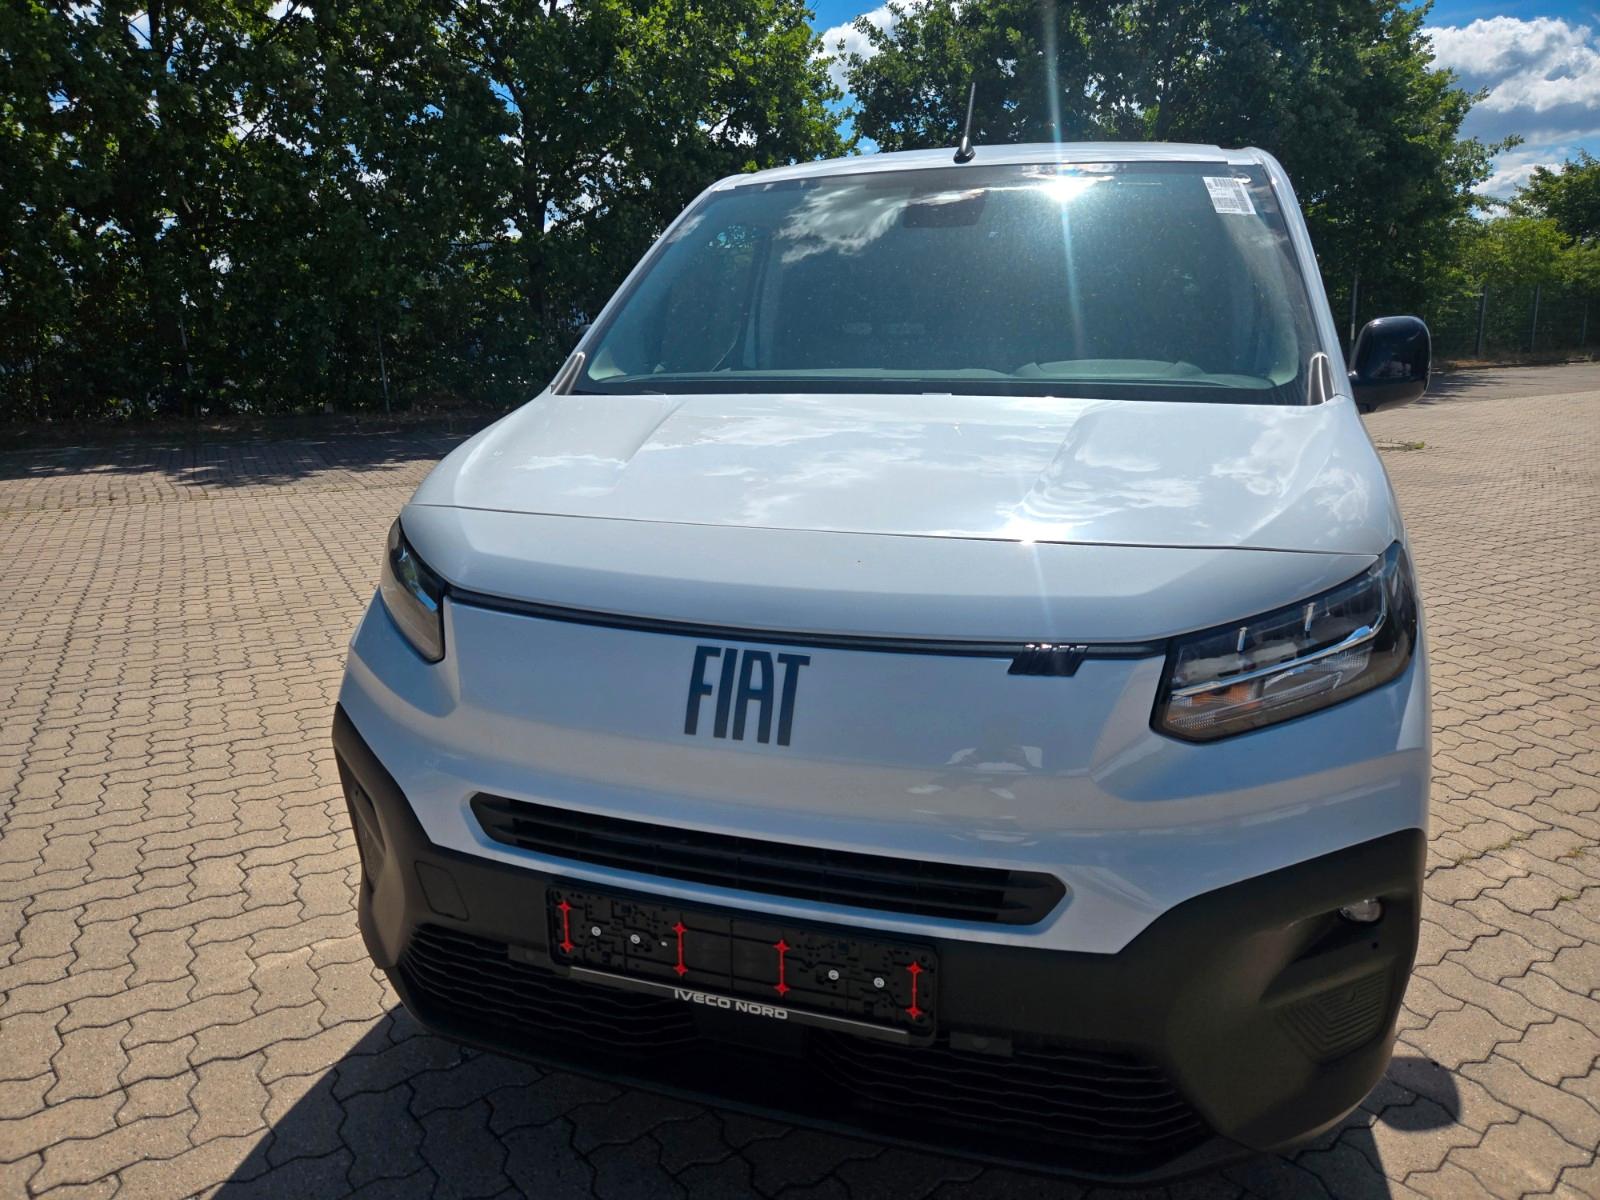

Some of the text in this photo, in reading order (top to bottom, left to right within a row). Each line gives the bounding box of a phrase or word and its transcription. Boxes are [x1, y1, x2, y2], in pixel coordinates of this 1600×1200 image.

[684, 645, 811, 746] FIAT
[674, 989, 788, 1019] IVECO NORD
